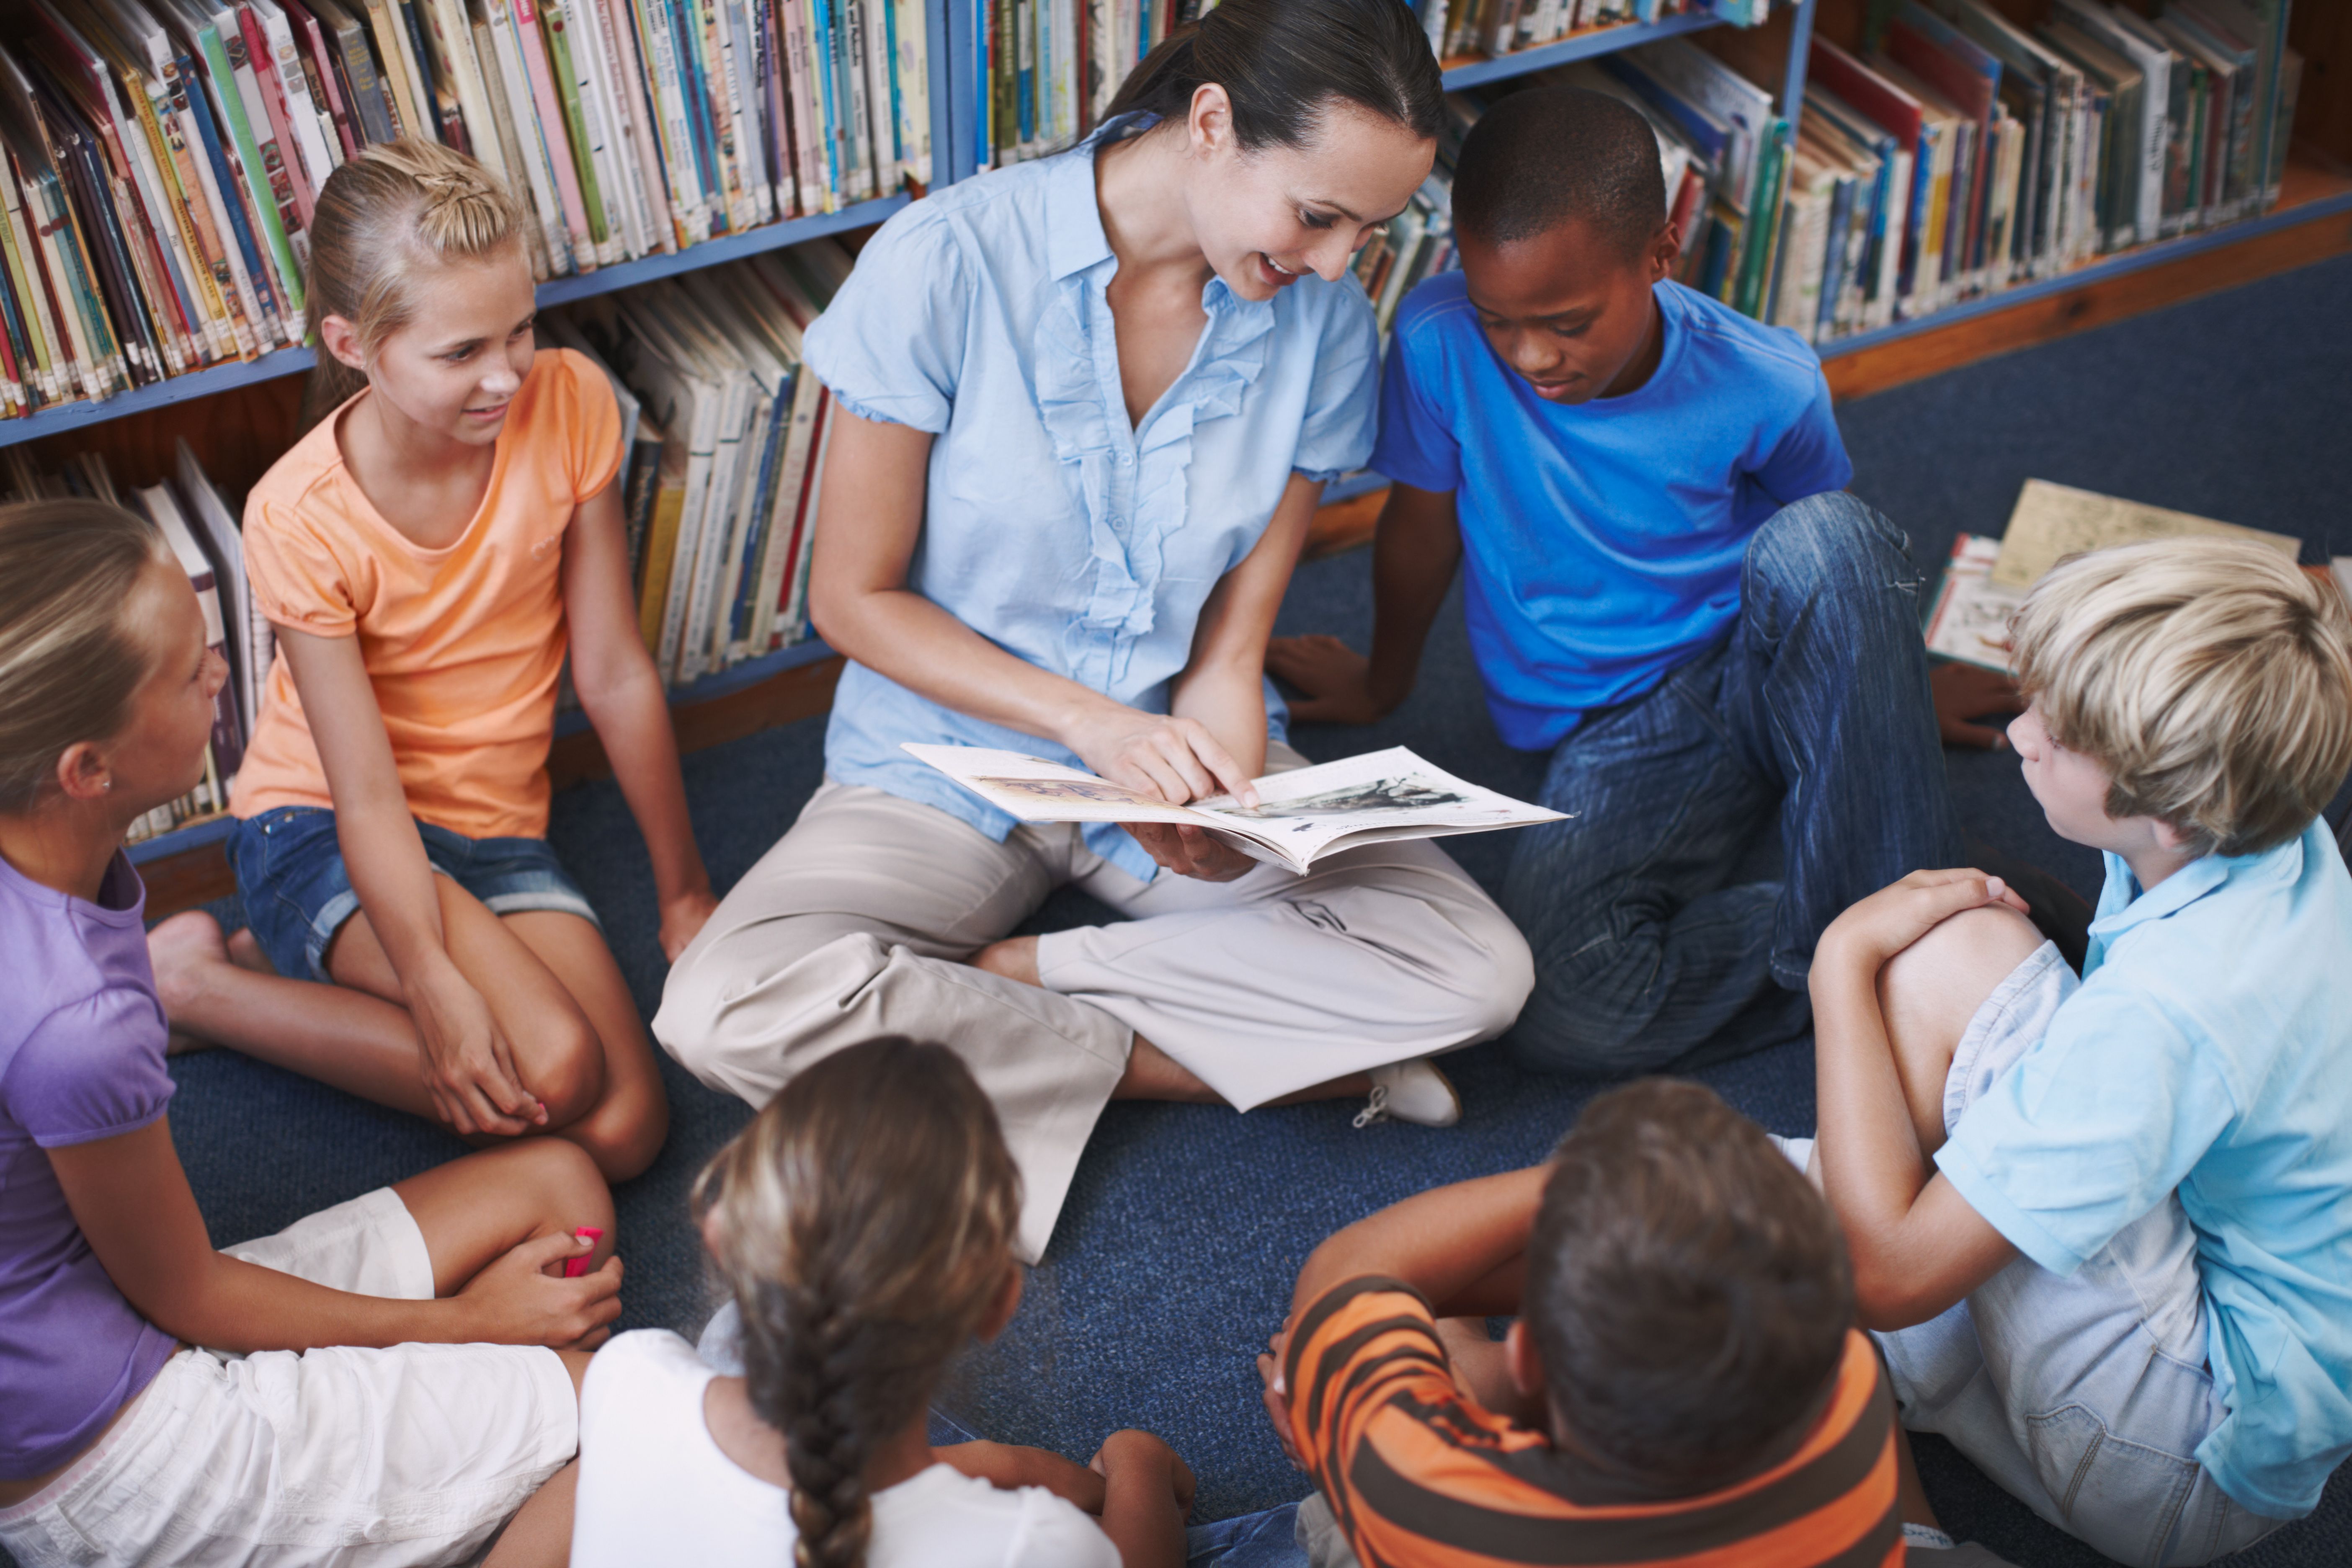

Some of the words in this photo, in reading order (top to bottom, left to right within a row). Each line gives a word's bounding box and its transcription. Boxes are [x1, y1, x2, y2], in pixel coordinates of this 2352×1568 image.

[609, 61, 624, 92] Baking
[616, 92, 628, 115] Book
[148, 125, 165, 157] REVOLTING
[160, 157, 173, 181] RECIPES
[212, 150, 222, 164] FOR
[216, 164, 227, 180] KIDS
[229, 204, 242, 219] Judy
[0, 222, 12, 245] FRUIT
[169, 233, 181, 248] Pitt
[174, 198, 192, 234] Illustrated
[187, 235, 195, 244] by
[191, 245, 207, 275] QUENTIN
[203, 275, 217, 299] BLAKE
